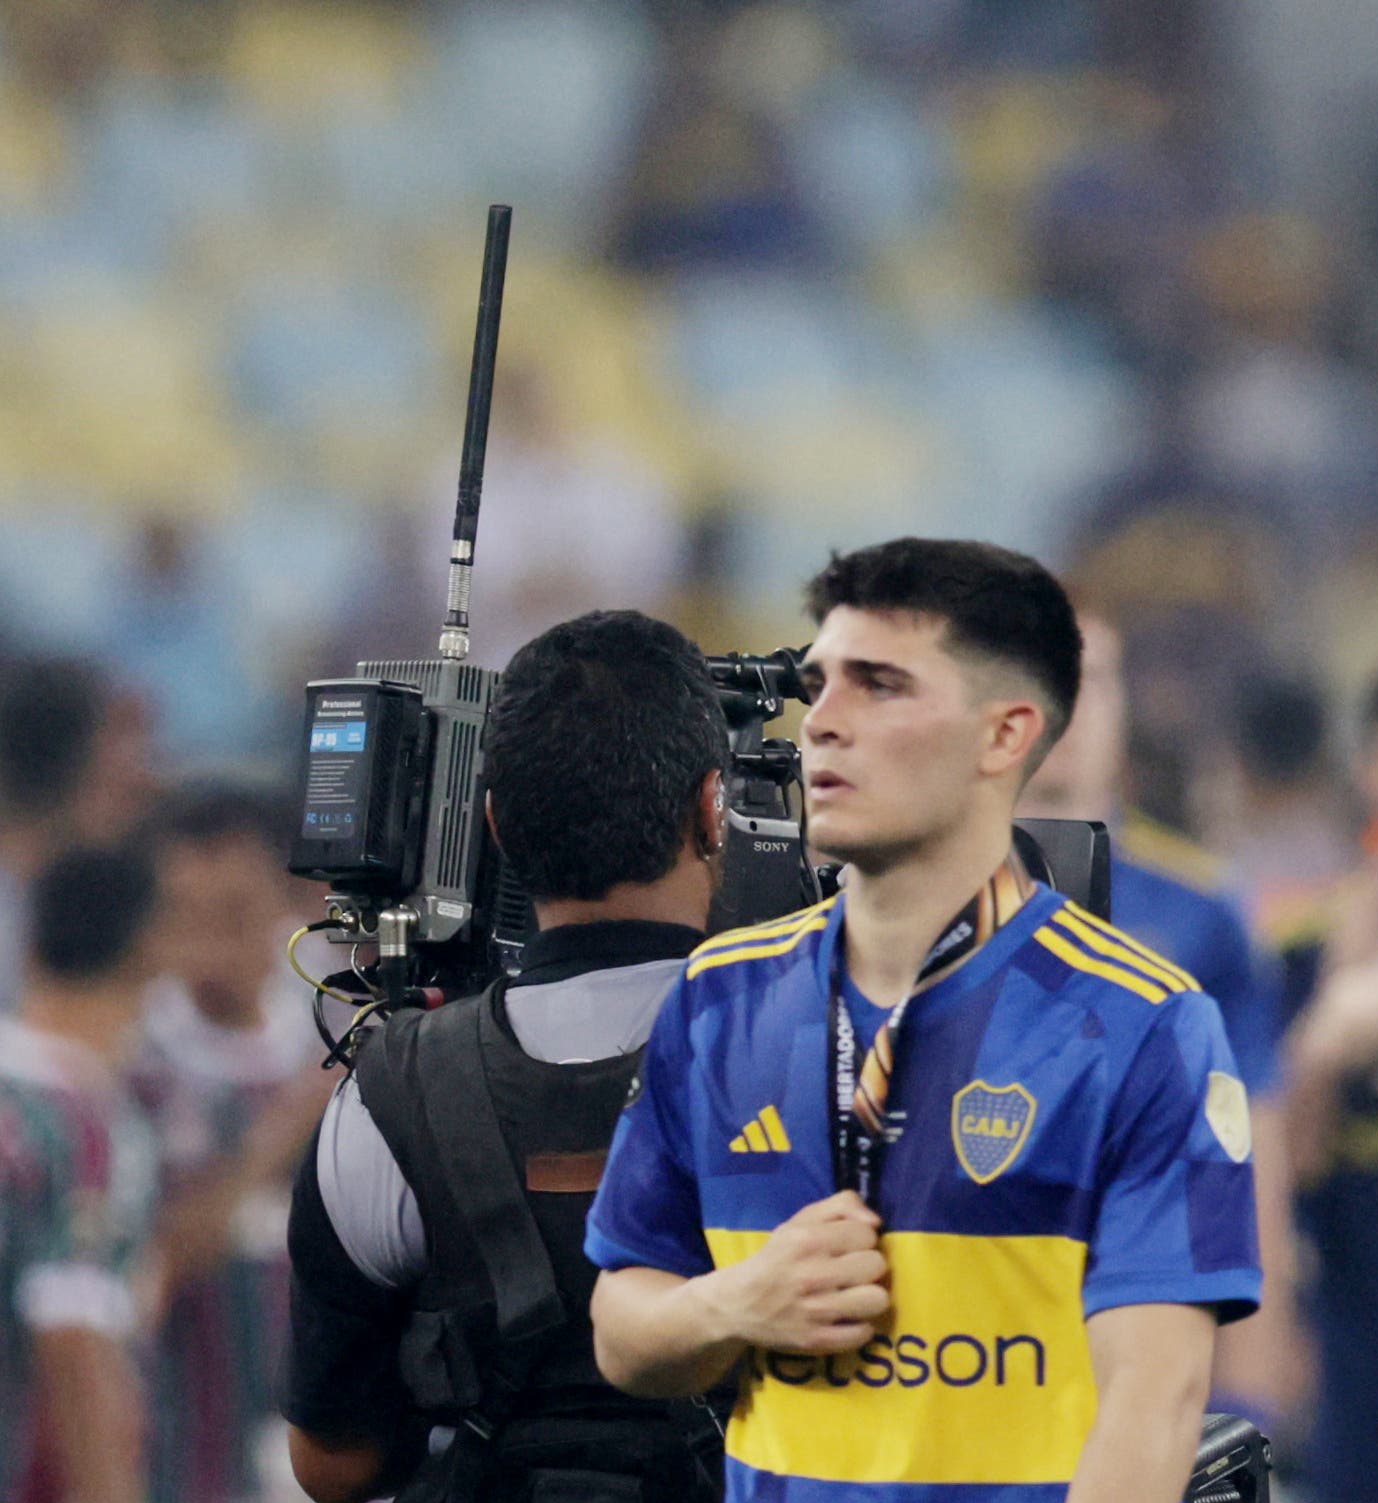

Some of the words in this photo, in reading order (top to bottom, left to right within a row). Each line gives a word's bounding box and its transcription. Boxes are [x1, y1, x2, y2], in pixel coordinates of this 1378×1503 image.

[753, 841, 790, 852] SONY
[961, 1115, 1020, 1138] CABJ
[752, 1334, 1045, 1388] etsson
